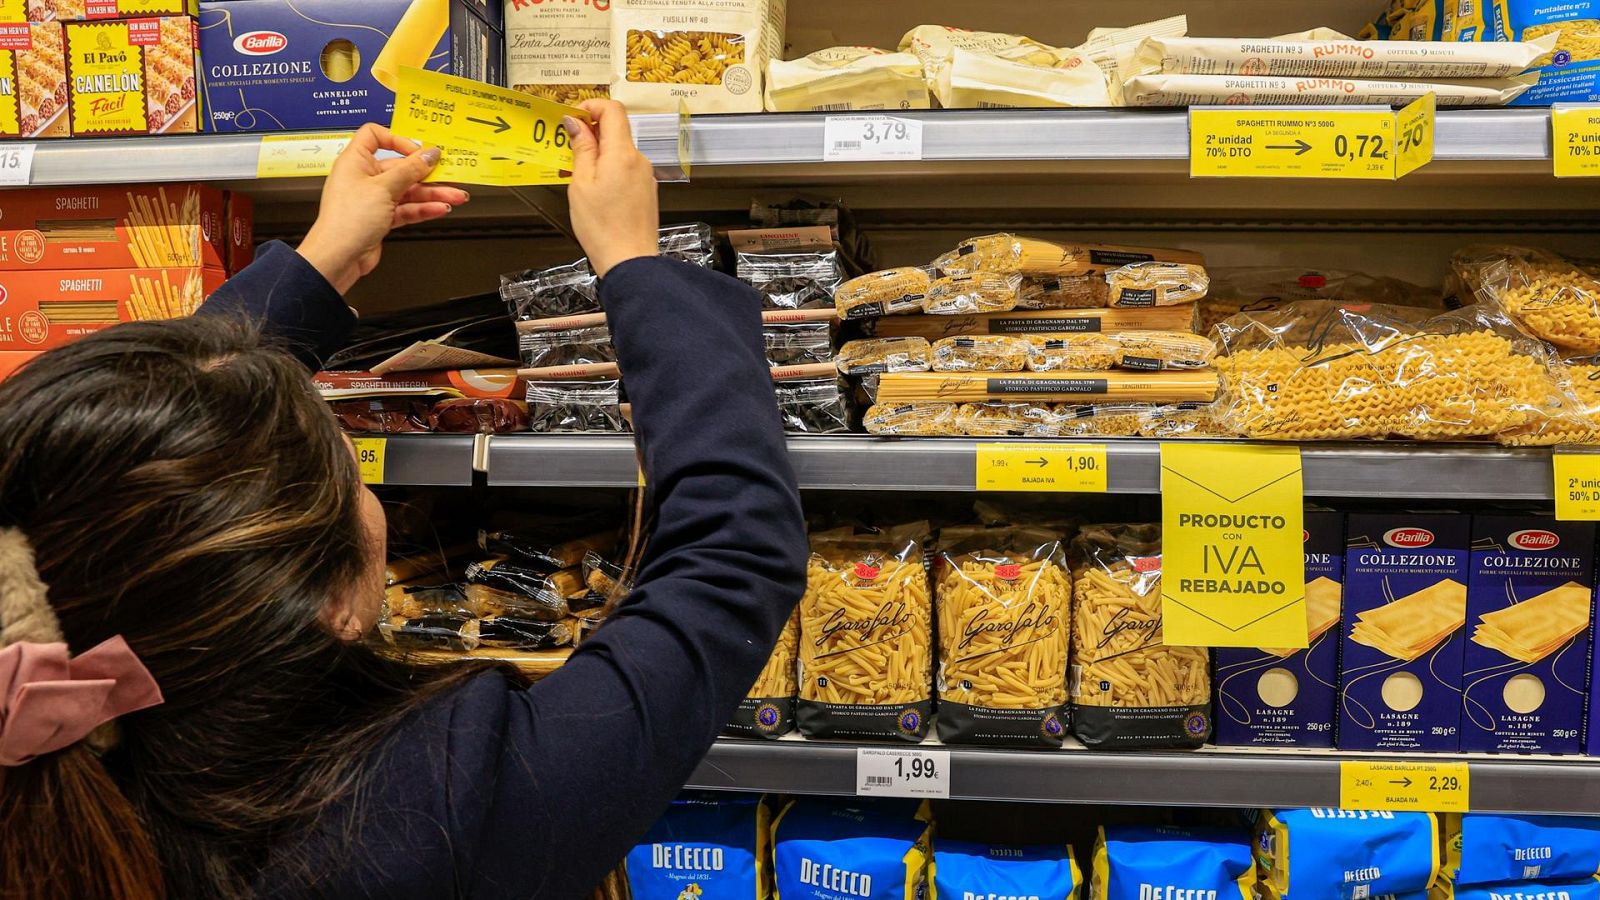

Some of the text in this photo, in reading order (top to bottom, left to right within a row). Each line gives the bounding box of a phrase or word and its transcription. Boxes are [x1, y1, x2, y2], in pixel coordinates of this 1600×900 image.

[662, 16, 688, 24] FUSILLI
[245, 36, 285, 49] Barilla
[510, 33, 542, 49] Lenta
[1241, 45, 1303, 54] SPAGHETTI 3
[1313, 45, 1374, 60] RUMMO
[84, 51, 127, 64] El Pavó
[212, 61, 311, 78] COLLEZIONE
[77, 69, 140, 94] CANELÓN
[1225, 80, 1286, 89] SPAGHETTI 3
[1296, 80, 1355, 93] RUMMO
[313, 90, 368, 99] CANNELLONI
[422, 98, 455, 112] unidad
[409, 107, 428, 121] 70%
[431, 112, 453, 125] DTO
[1277, 120, 1303, 128] RUMMO
[534, 119, 572, 150] 0,6
[1206, 134, 1252, 144] 2ª unidad
[1569, 133, 1578, 143] 2ª
[1206, 147, 1252, 157] 70% DTO
[1569, 145, 1590, 156] 70%
[56, 197, 99, 210] SPAGHETTI
[59, 279, 103, 292] SPAGHETTI
[767, 314, 806, 322] LINGUINE
[769, 370, 804, 378] NGUINE
[350, 381, 428, 389] SPAGHETTI INTEGRAL
[1569, 478, 1579, 488] 2ª
[1569, 491, 1590, 501] 50%
[1179, 513, 1286, 529] PRODUCTO
[1394, 532, 1430, 543] Barilla
[1519, 534, 1555, 545] Barilla
[1203, 545, 1265, 575] IVA
[1360, 554, 1456, 566] COLLEZIONE
[1483, 557, 1581, 569] COLLEZIONE
[1180, 579, 1286, 594] REBAJADO
[816, 602, 916, 647] Garofalo
[958, 603, 1059, 650] Garofalo
